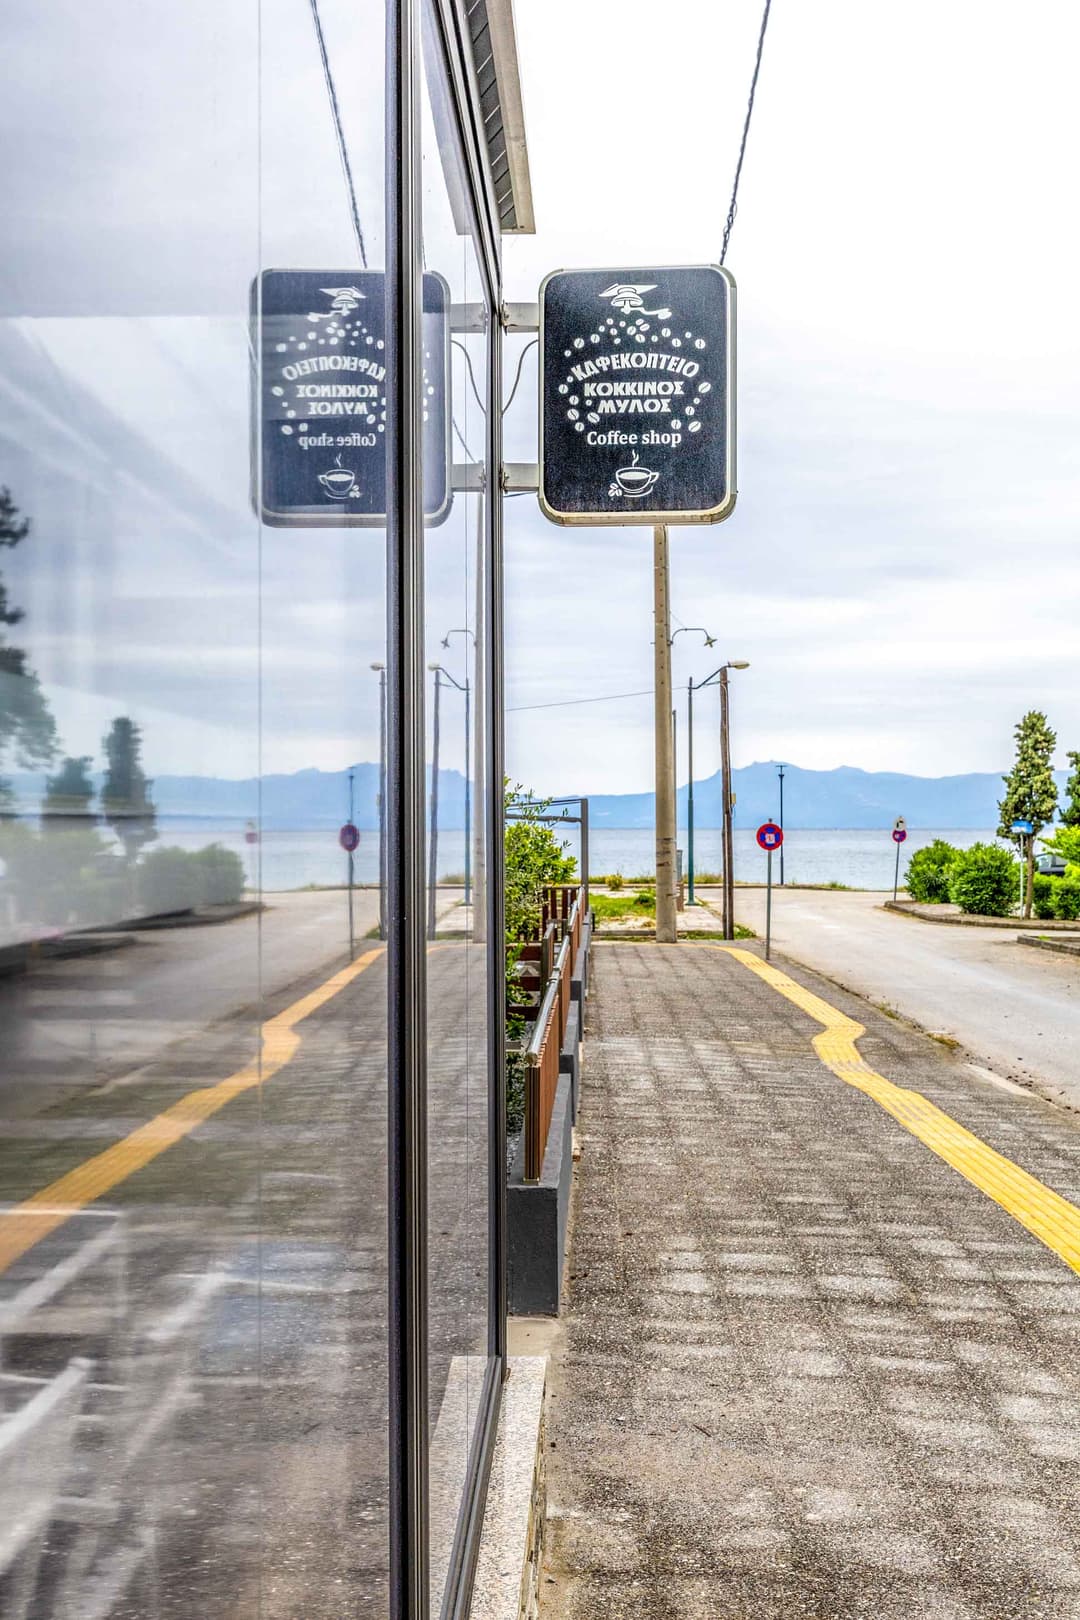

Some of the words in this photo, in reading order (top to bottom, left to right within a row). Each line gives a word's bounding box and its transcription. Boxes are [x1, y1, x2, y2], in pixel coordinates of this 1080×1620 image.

[570, 352, 700, 382] ΚΑΦΕΚΟΠΤΕΙΟ
[584, 380, 685, 397] ΚΟΚΚΙΝΟΣ
[597, 398, 672, 414] ΜΥΛΟΣ
[587, 431, 638, 446] Coffee
[641, 430, 682, 448] shop
